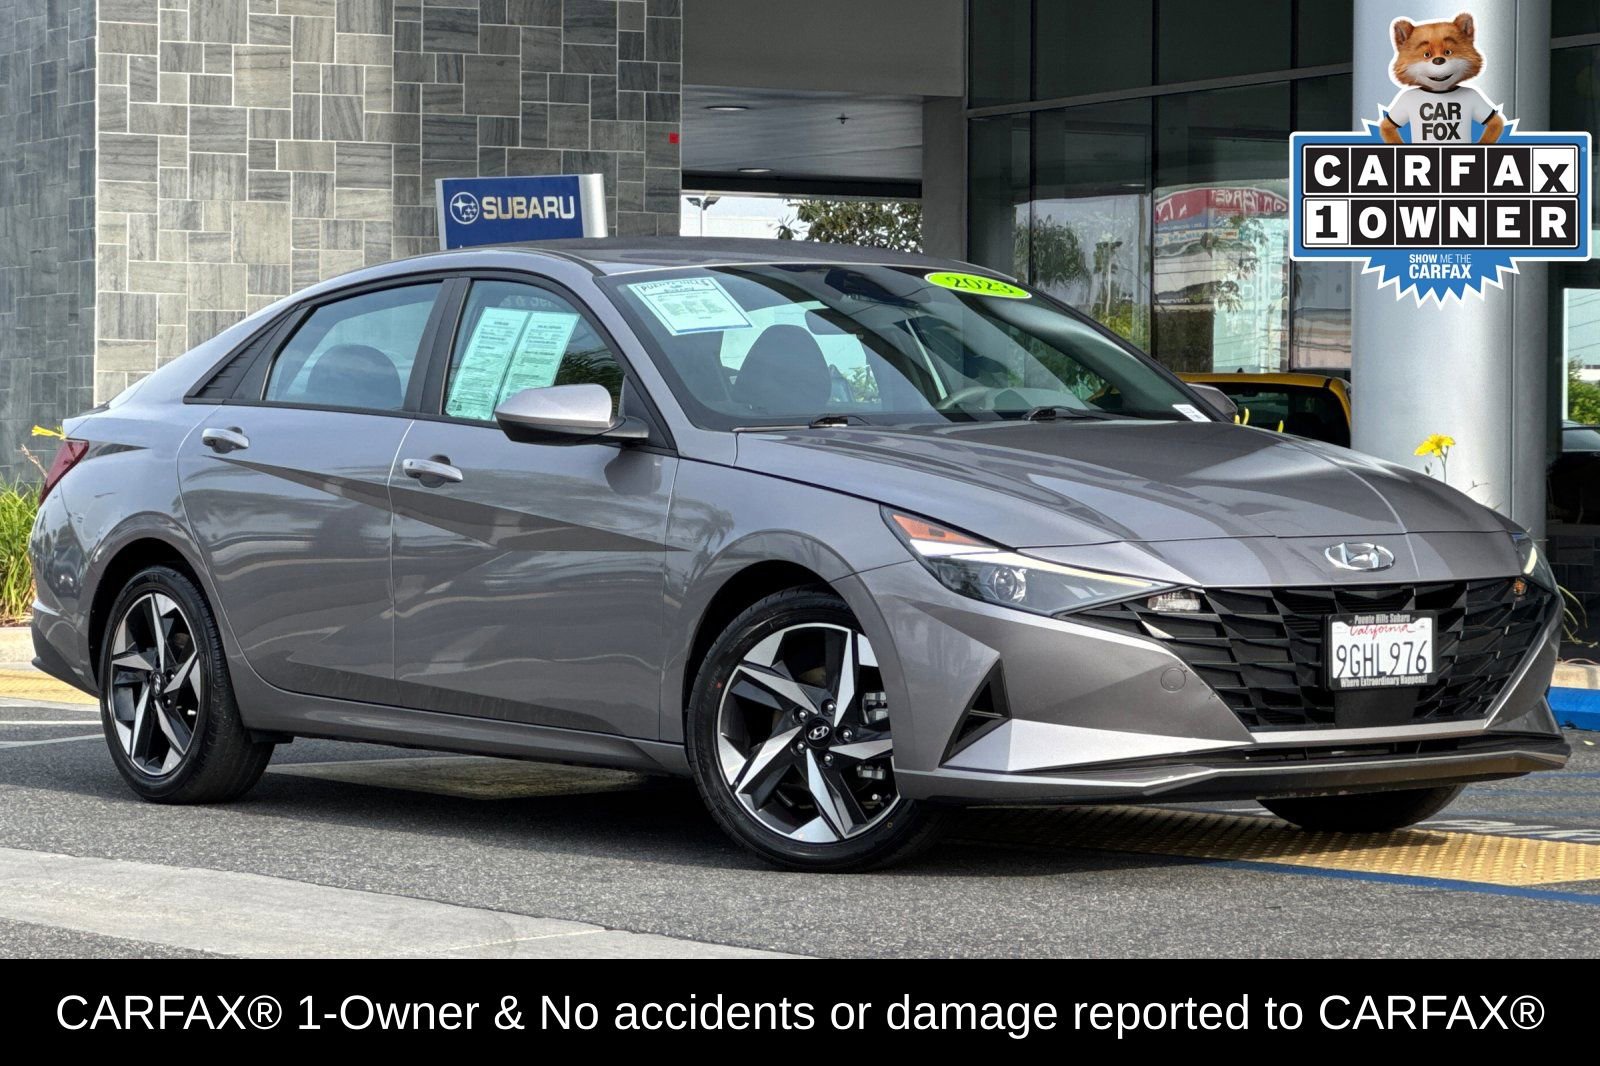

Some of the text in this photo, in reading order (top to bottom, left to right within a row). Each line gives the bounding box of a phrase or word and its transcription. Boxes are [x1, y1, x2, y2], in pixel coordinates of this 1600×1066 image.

[482, 195, 576, 220] SUBARU
[1354, 613, 1411, 624] Puente Hills Subaru
[1350, 624, 1416, 640] California
[1336, 640, 1428, 678] 9GHL976
[1341, 677, 1360, 688] Where
